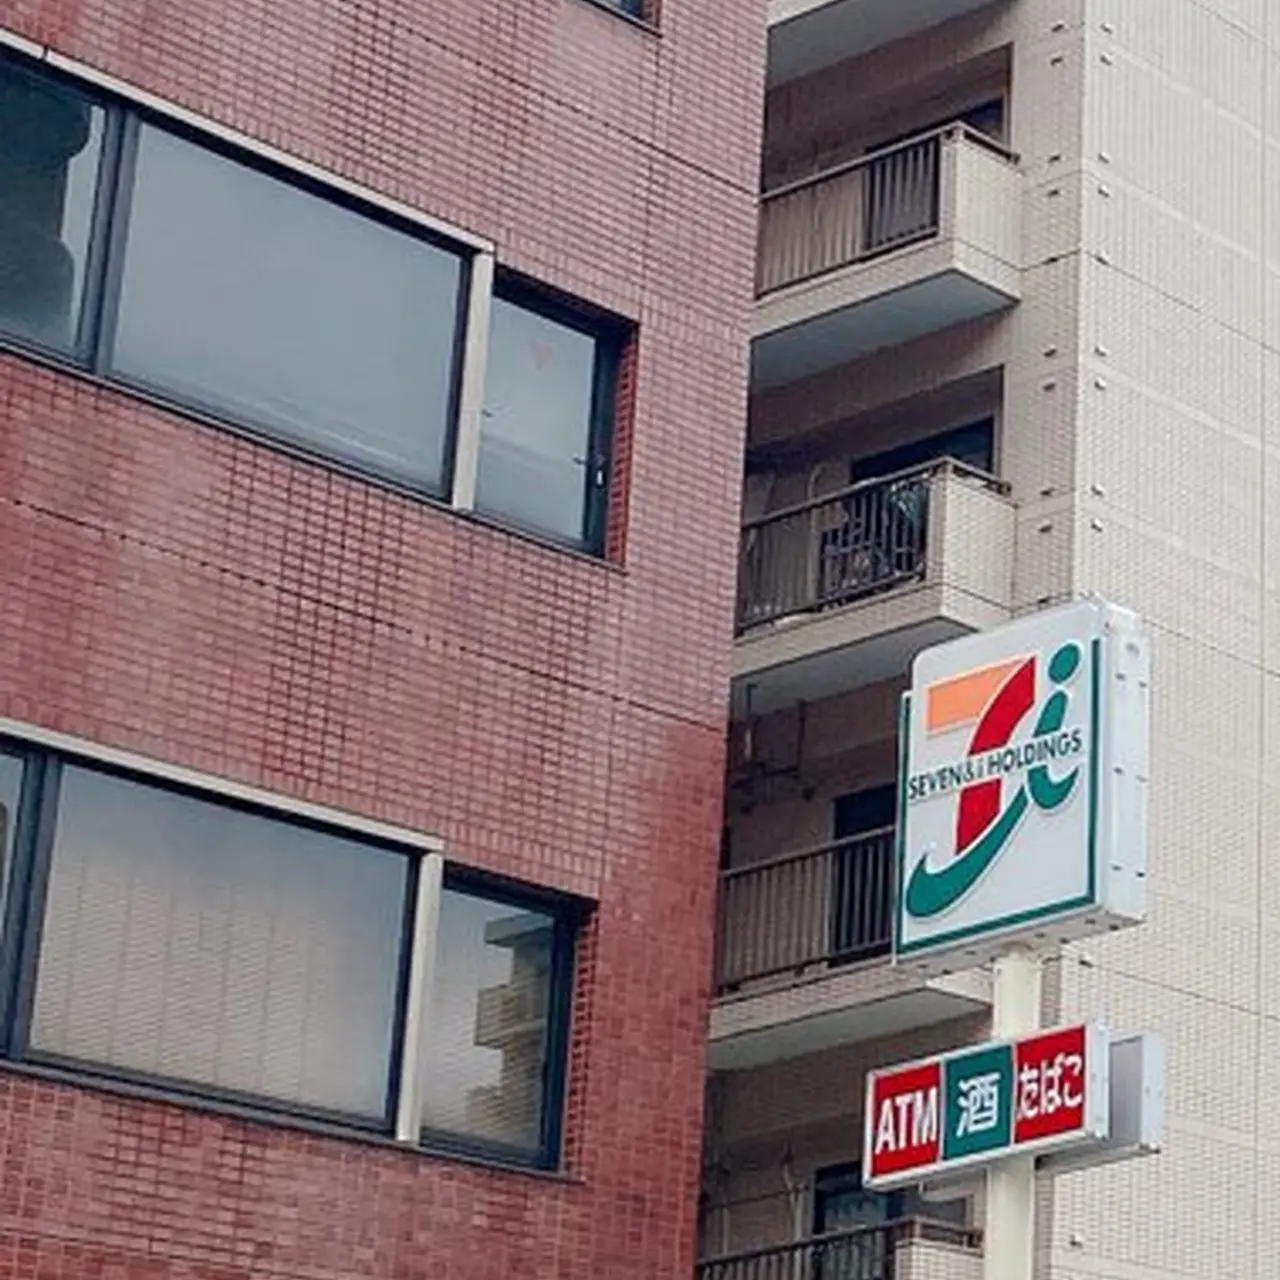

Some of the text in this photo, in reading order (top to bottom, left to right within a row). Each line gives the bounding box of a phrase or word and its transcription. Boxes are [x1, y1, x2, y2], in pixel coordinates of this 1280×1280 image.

[986, 728, 1083, 778] HOLDINGS
[955, 1070, 1001, 1138] 酒
[1015, 1053, 1084, 1120] たばこ
[874, 1086, 938, 1157] ATM
